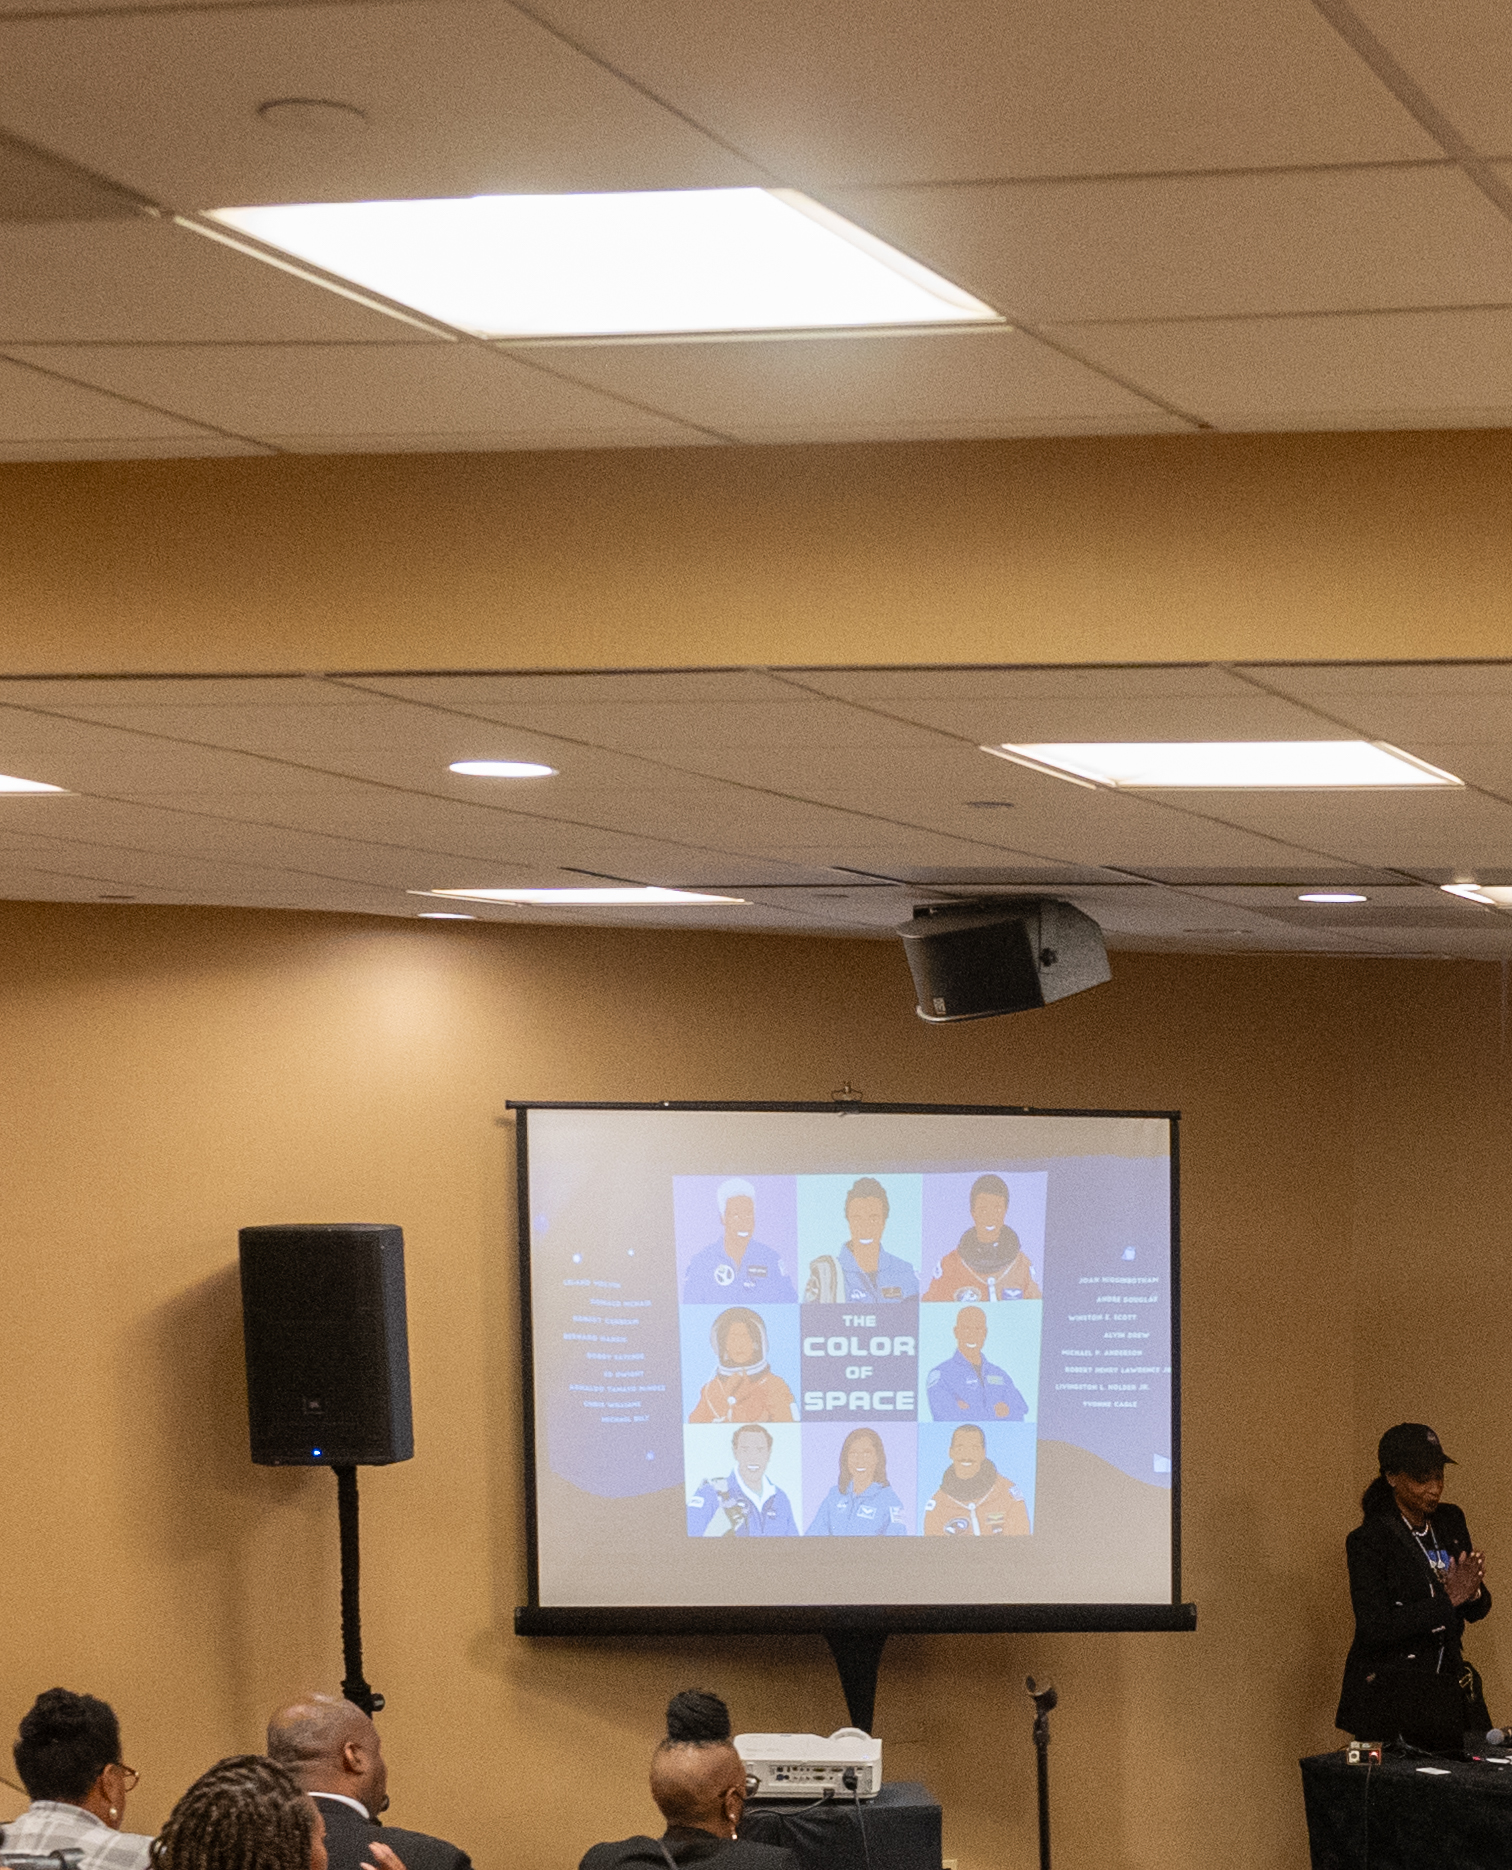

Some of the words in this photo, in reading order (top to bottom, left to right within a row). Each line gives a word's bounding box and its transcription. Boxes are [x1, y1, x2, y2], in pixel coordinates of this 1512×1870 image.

[842, 1314, 877, 1327] THE
[803, 1336, 915, 1357] COLOR
[845, 1366, 873, 1379] OF
[804, 1390, 915, 1411] SPACE
